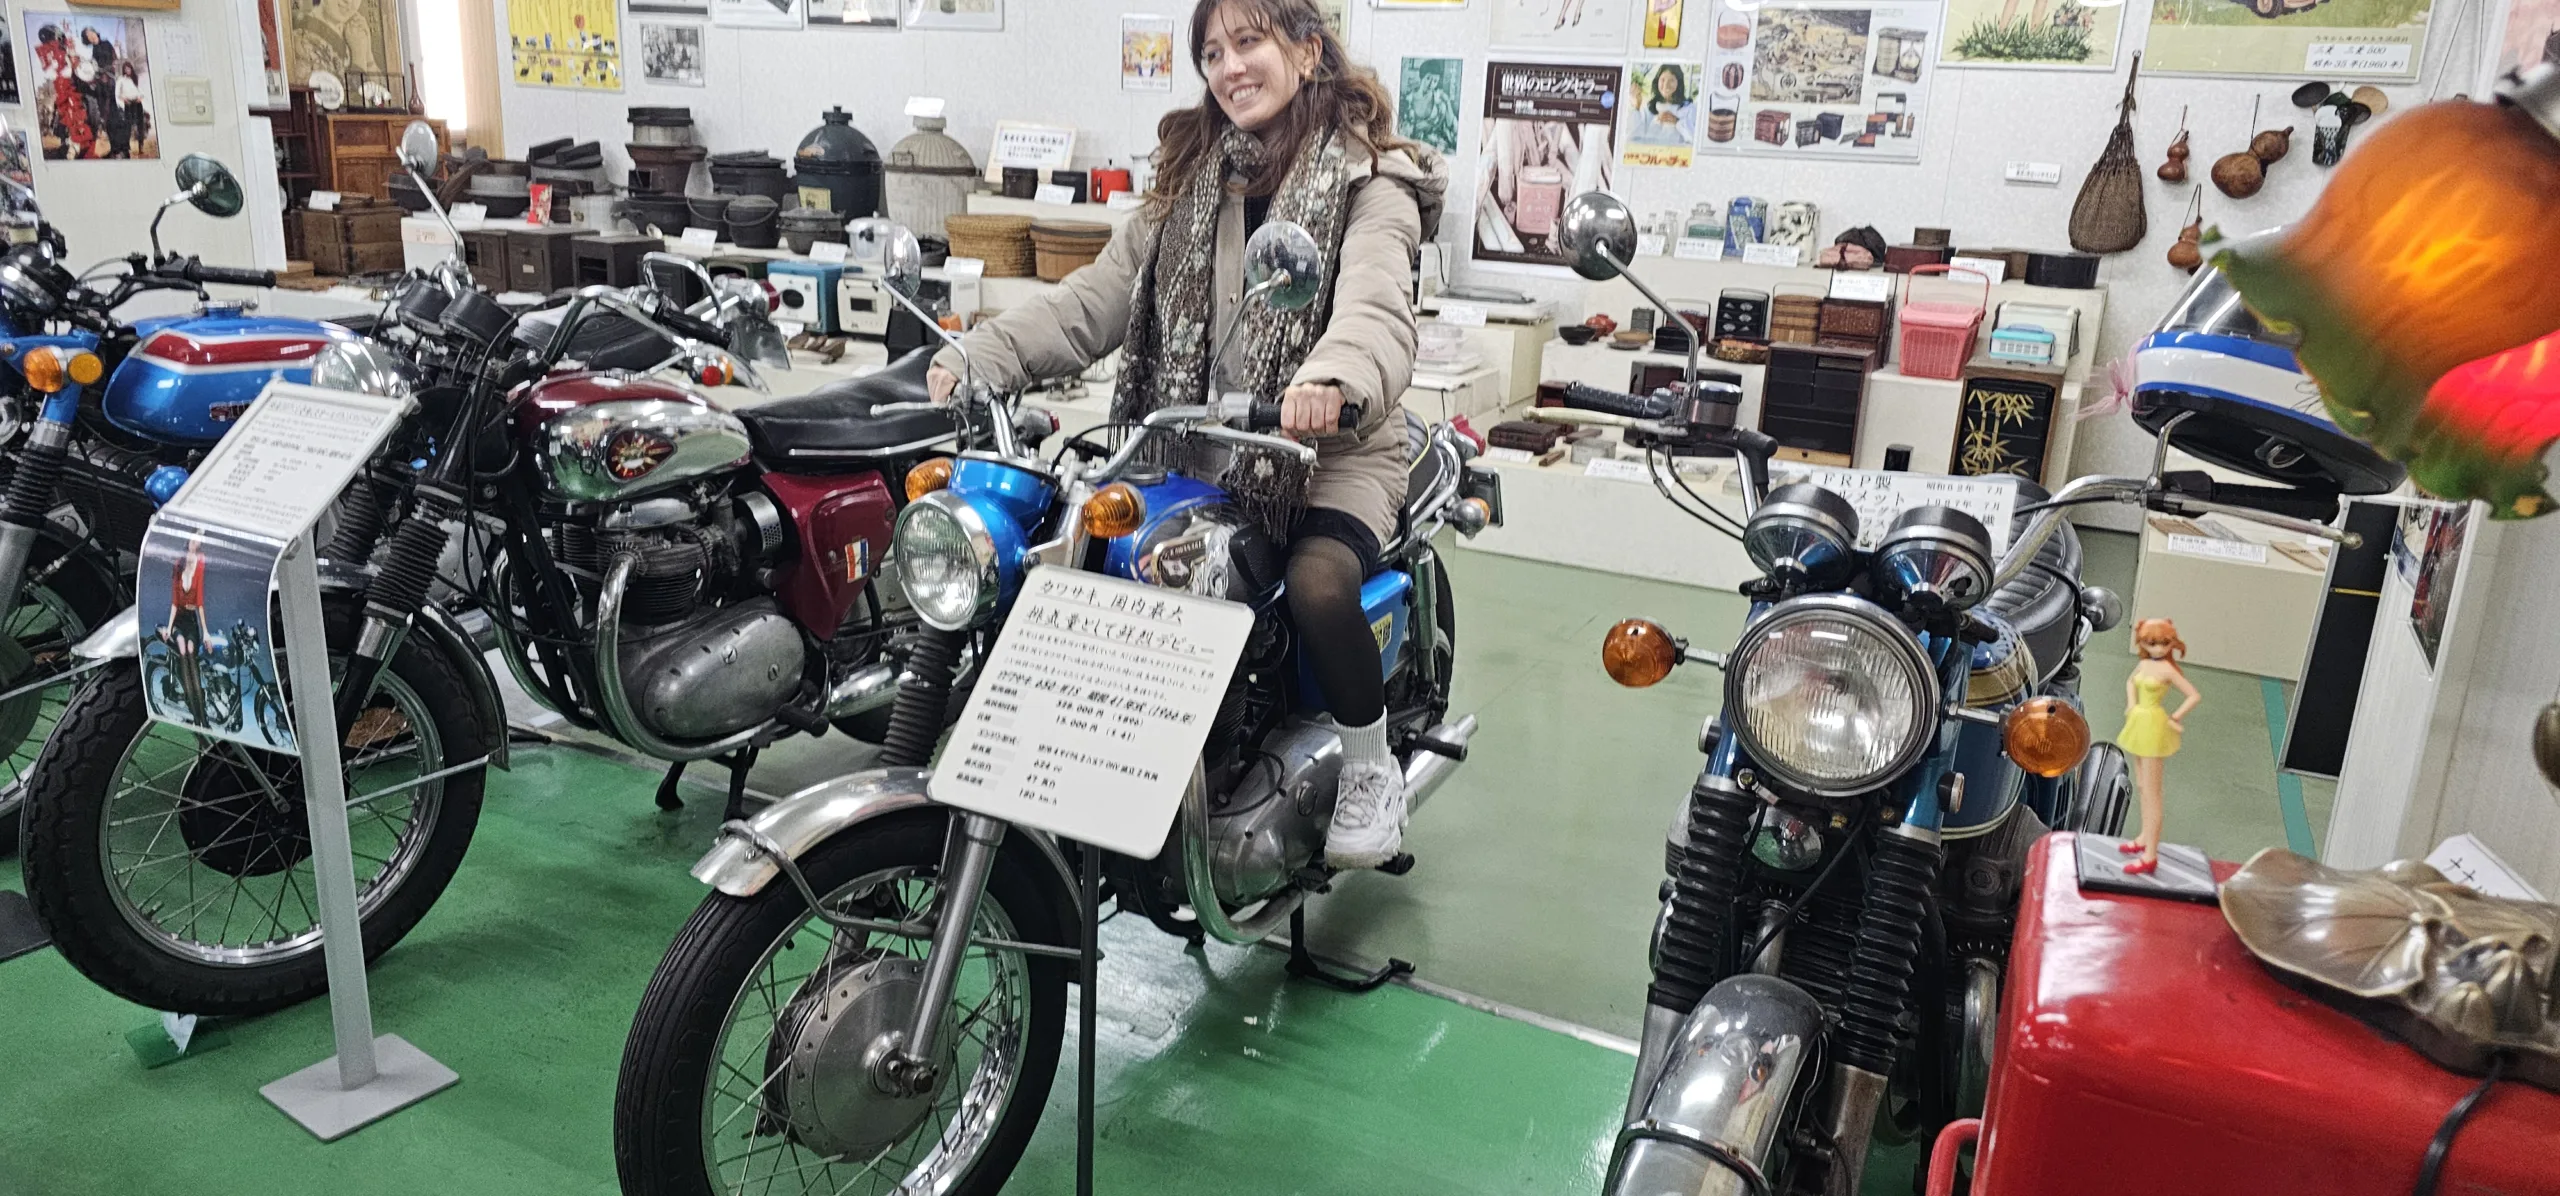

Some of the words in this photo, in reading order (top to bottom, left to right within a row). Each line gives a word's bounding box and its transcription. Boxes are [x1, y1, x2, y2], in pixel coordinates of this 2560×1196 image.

[1501, 73, 1608, 95] 世界のロングセラー
[1040, 580, 1185, 624] カワサキ、国内最大
[1026, 606, 1216, 655] 排気量として鮮烈デビュー
